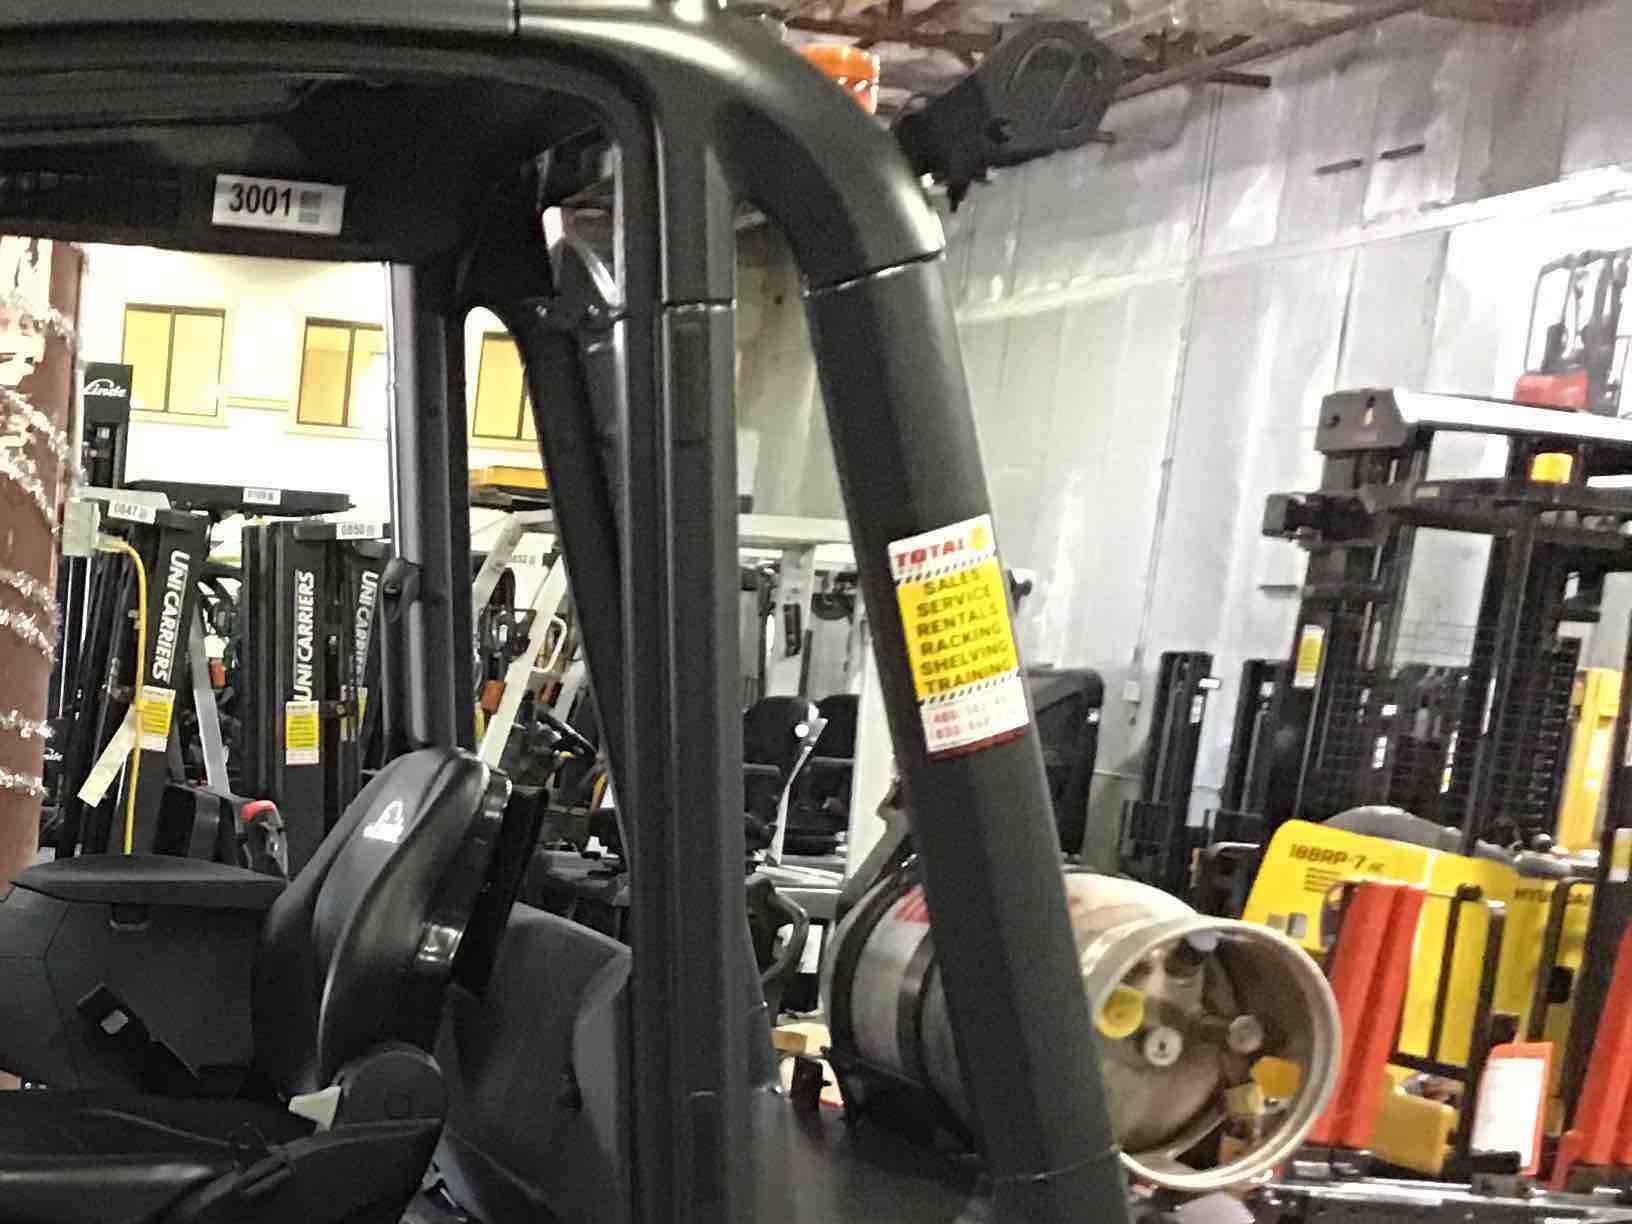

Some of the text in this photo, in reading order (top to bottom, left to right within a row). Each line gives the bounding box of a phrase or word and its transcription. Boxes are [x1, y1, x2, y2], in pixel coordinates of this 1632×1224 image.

[228, 182, 292, 216] 3001
[923, 569, 981, 596] SALES
[151, 550, 190, 683] UNICARRIERS
[916, 584, 991, 618] SERVICE
[293, 570, 315, 702] UNICARRIERS
[916, 602, 999, 638] RENTALS
[920, 621, 1002, 656] RACKING
[920, 640, 1009, 676] SHELVING
[924, 658, 1011, 693] TRAINING
